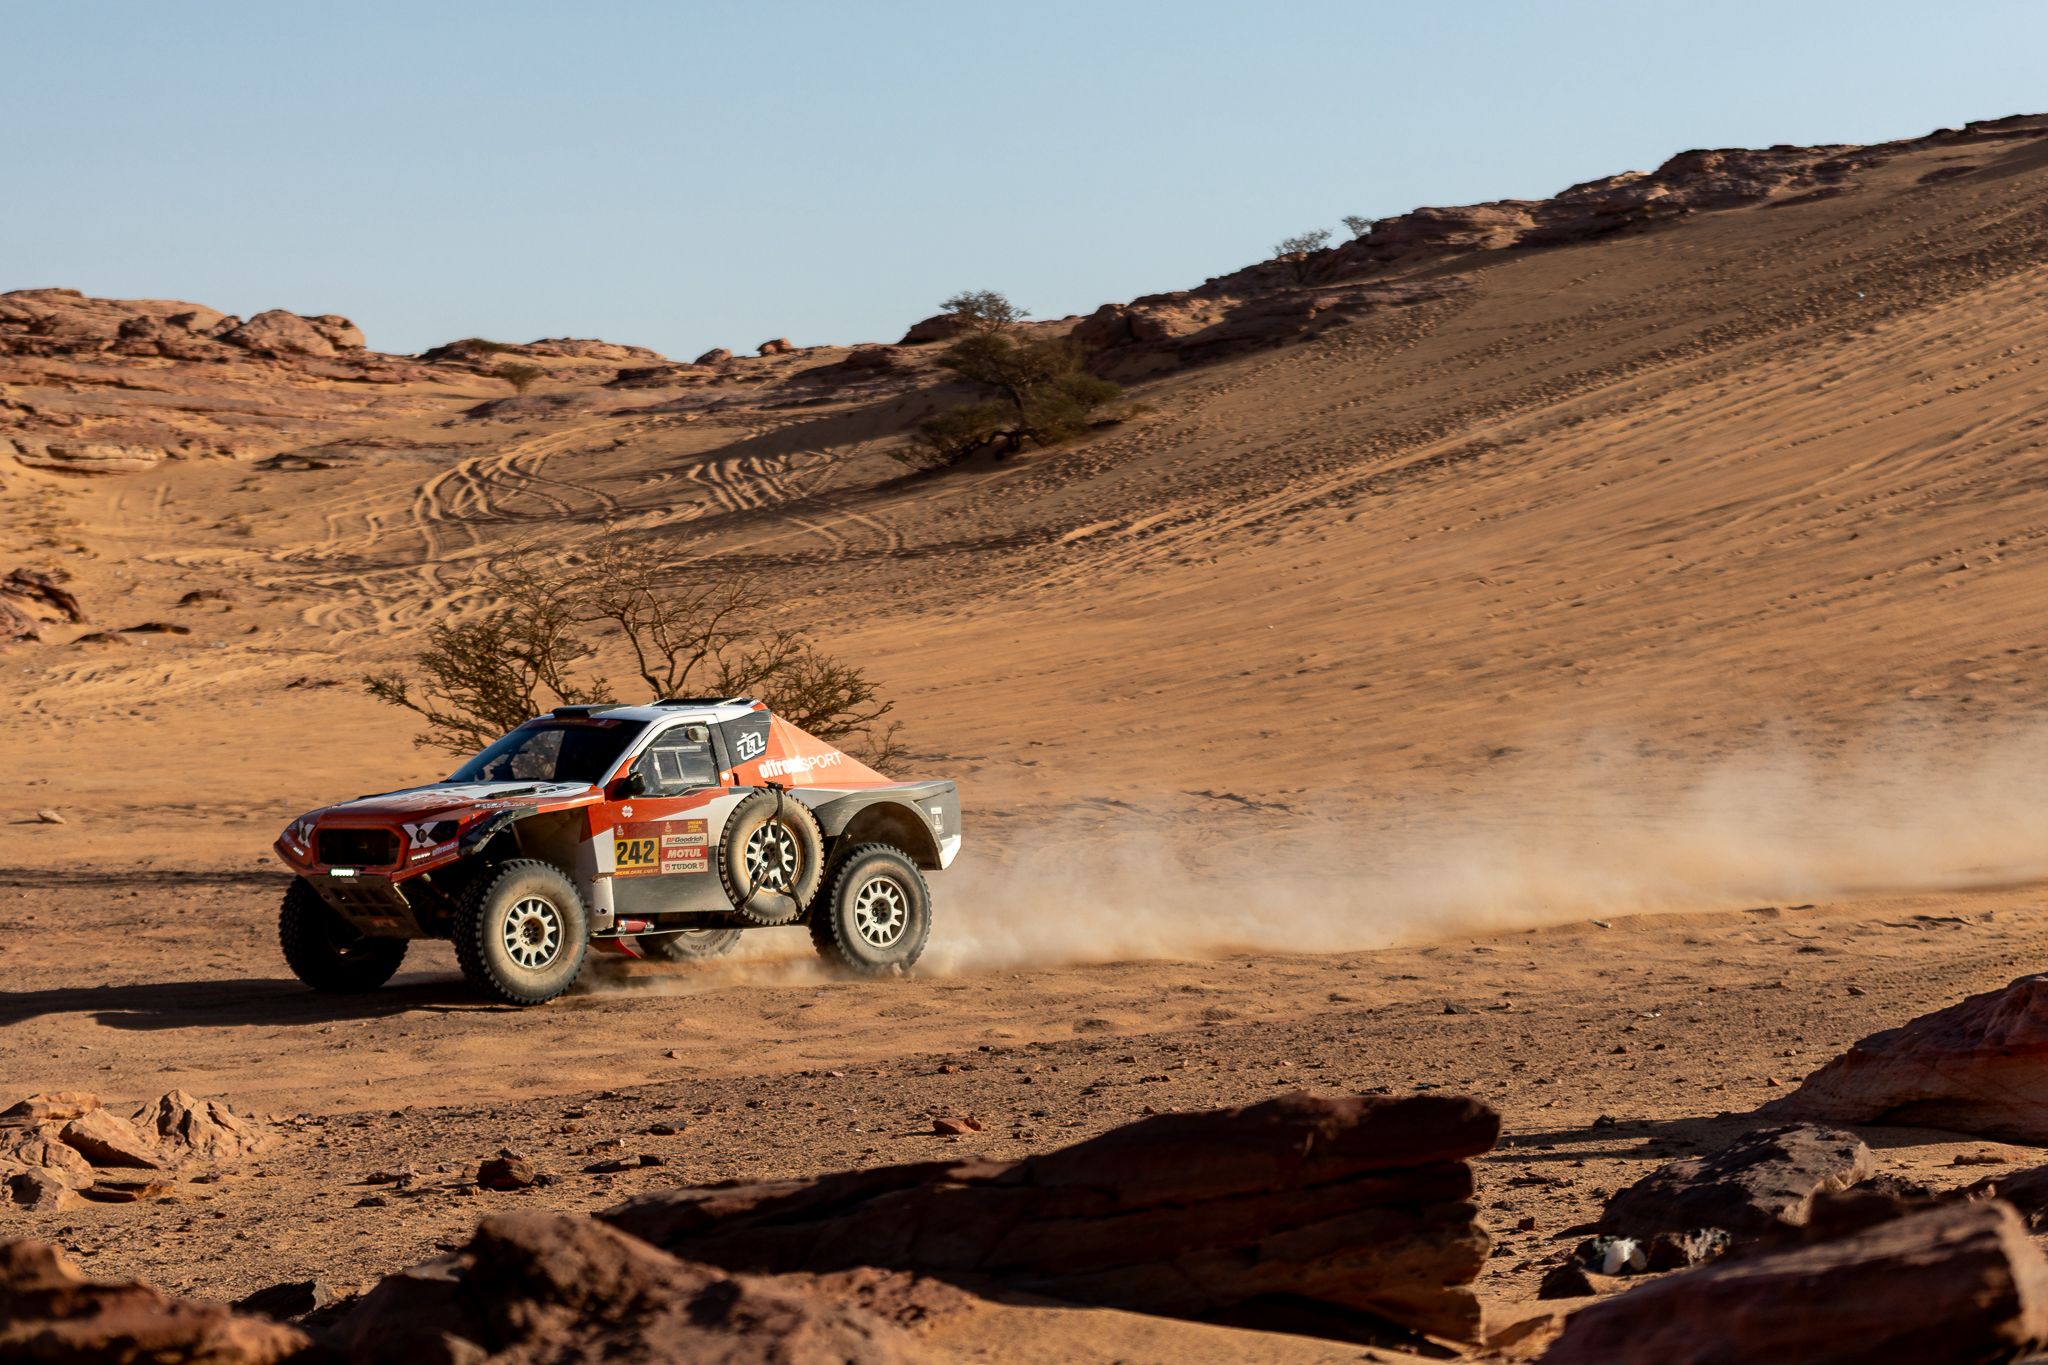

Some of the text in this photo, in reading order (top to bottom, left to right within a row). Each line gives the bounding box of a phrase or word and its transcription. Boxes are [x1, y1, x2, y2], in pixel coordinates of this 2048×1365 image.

[616, 840, 655, 866] 242
[667, 848, 702, 859] MOTUL
[671, 862, 698, 871] TUDOR
